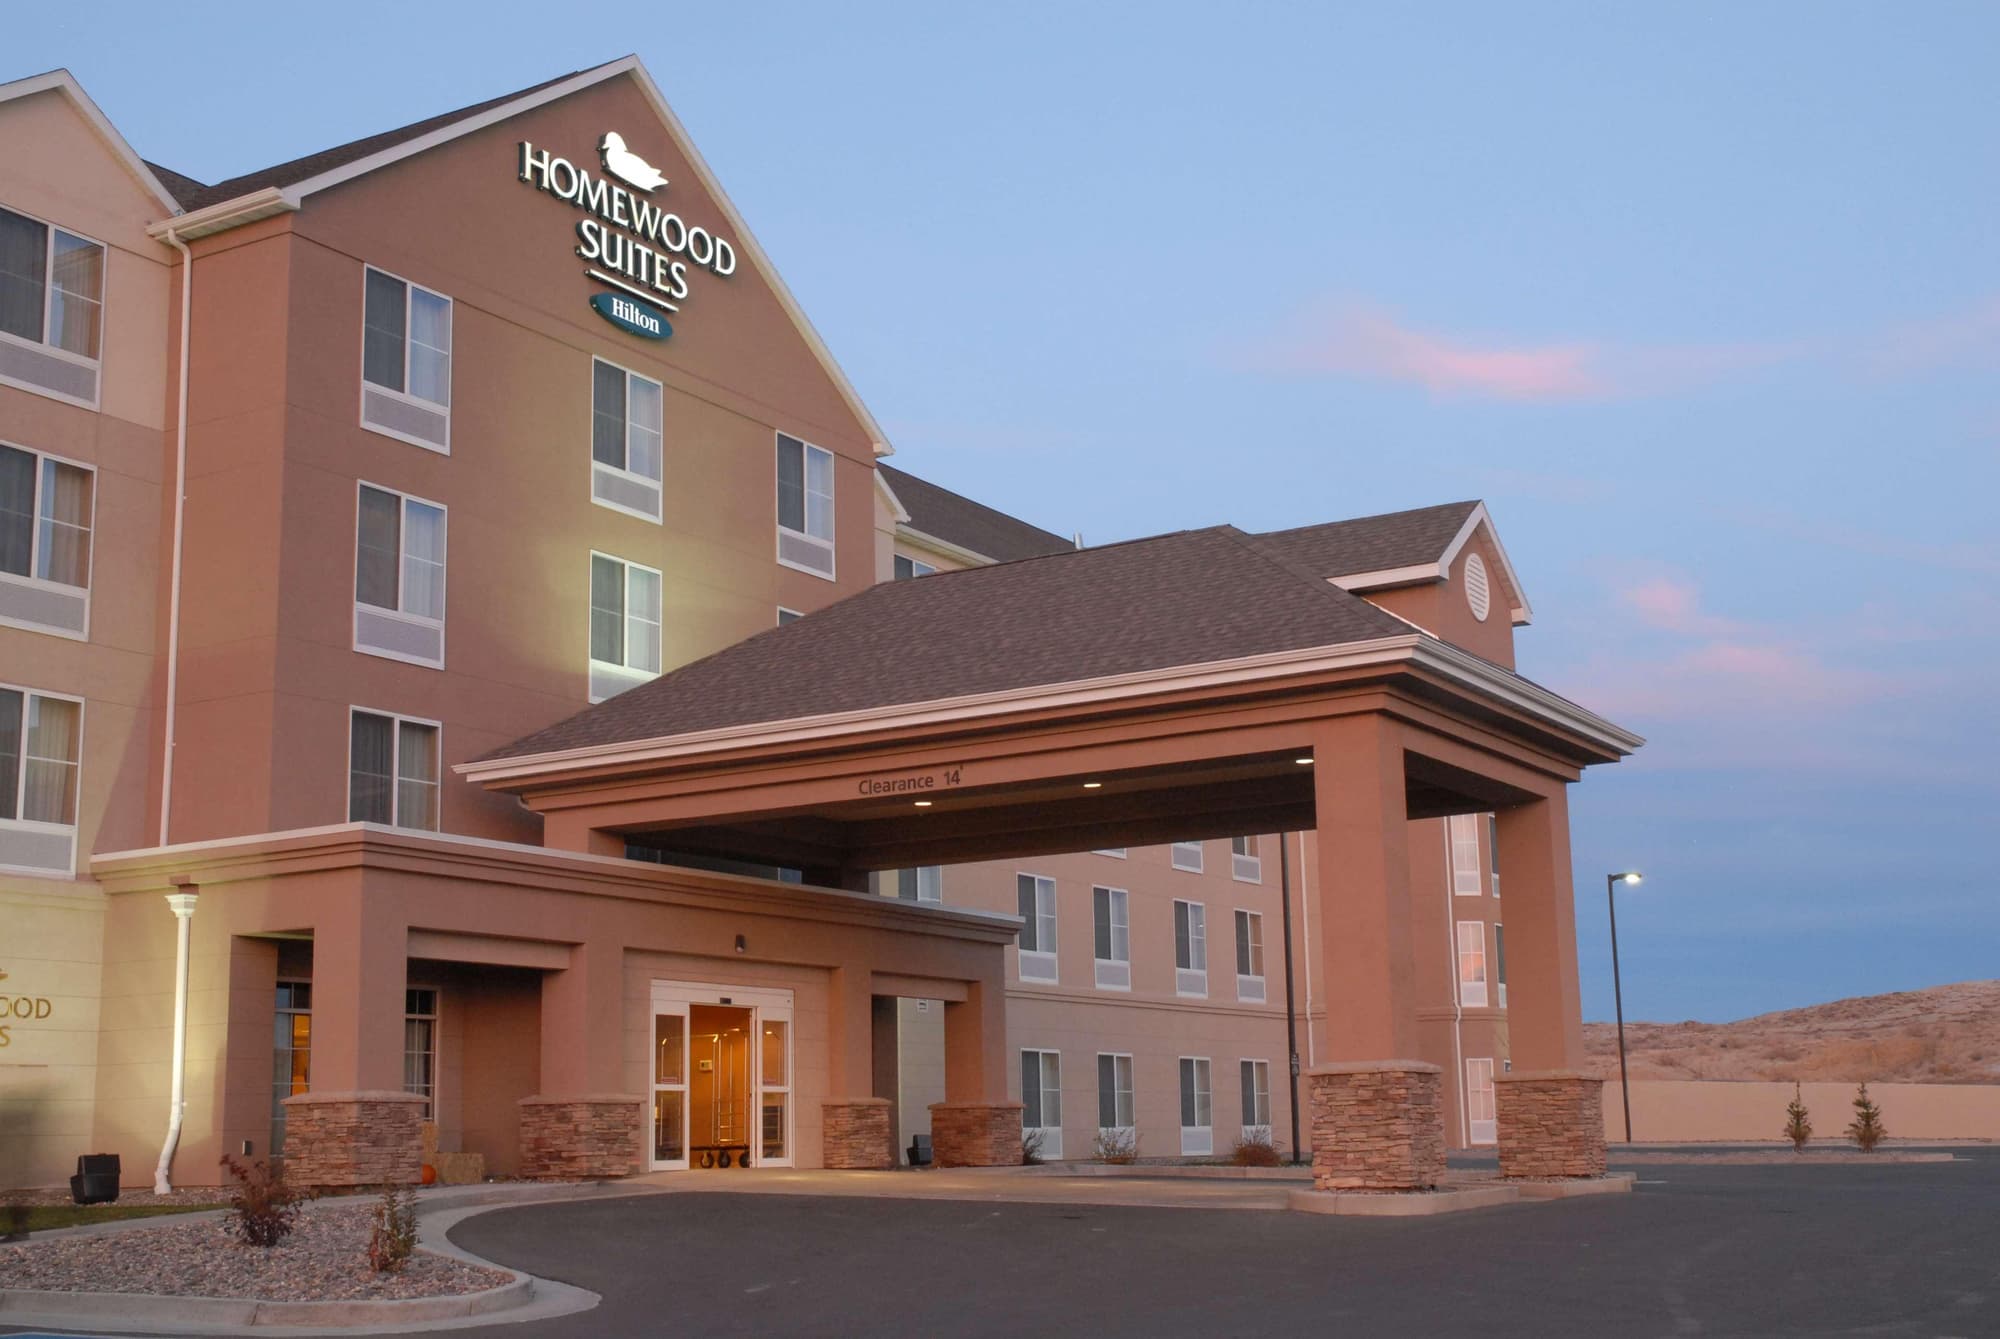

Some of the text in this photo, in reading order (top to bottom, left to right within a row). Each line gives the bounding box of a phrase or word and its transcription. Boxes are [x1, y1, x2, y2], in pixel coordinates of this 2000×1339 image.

[519, 141, 737, 276] HOMEWOOD
[576, 219, 688, 299] SUITES
[611, 297, 661, 334] Hilton
[858, 775, 934, 795] Clearance
